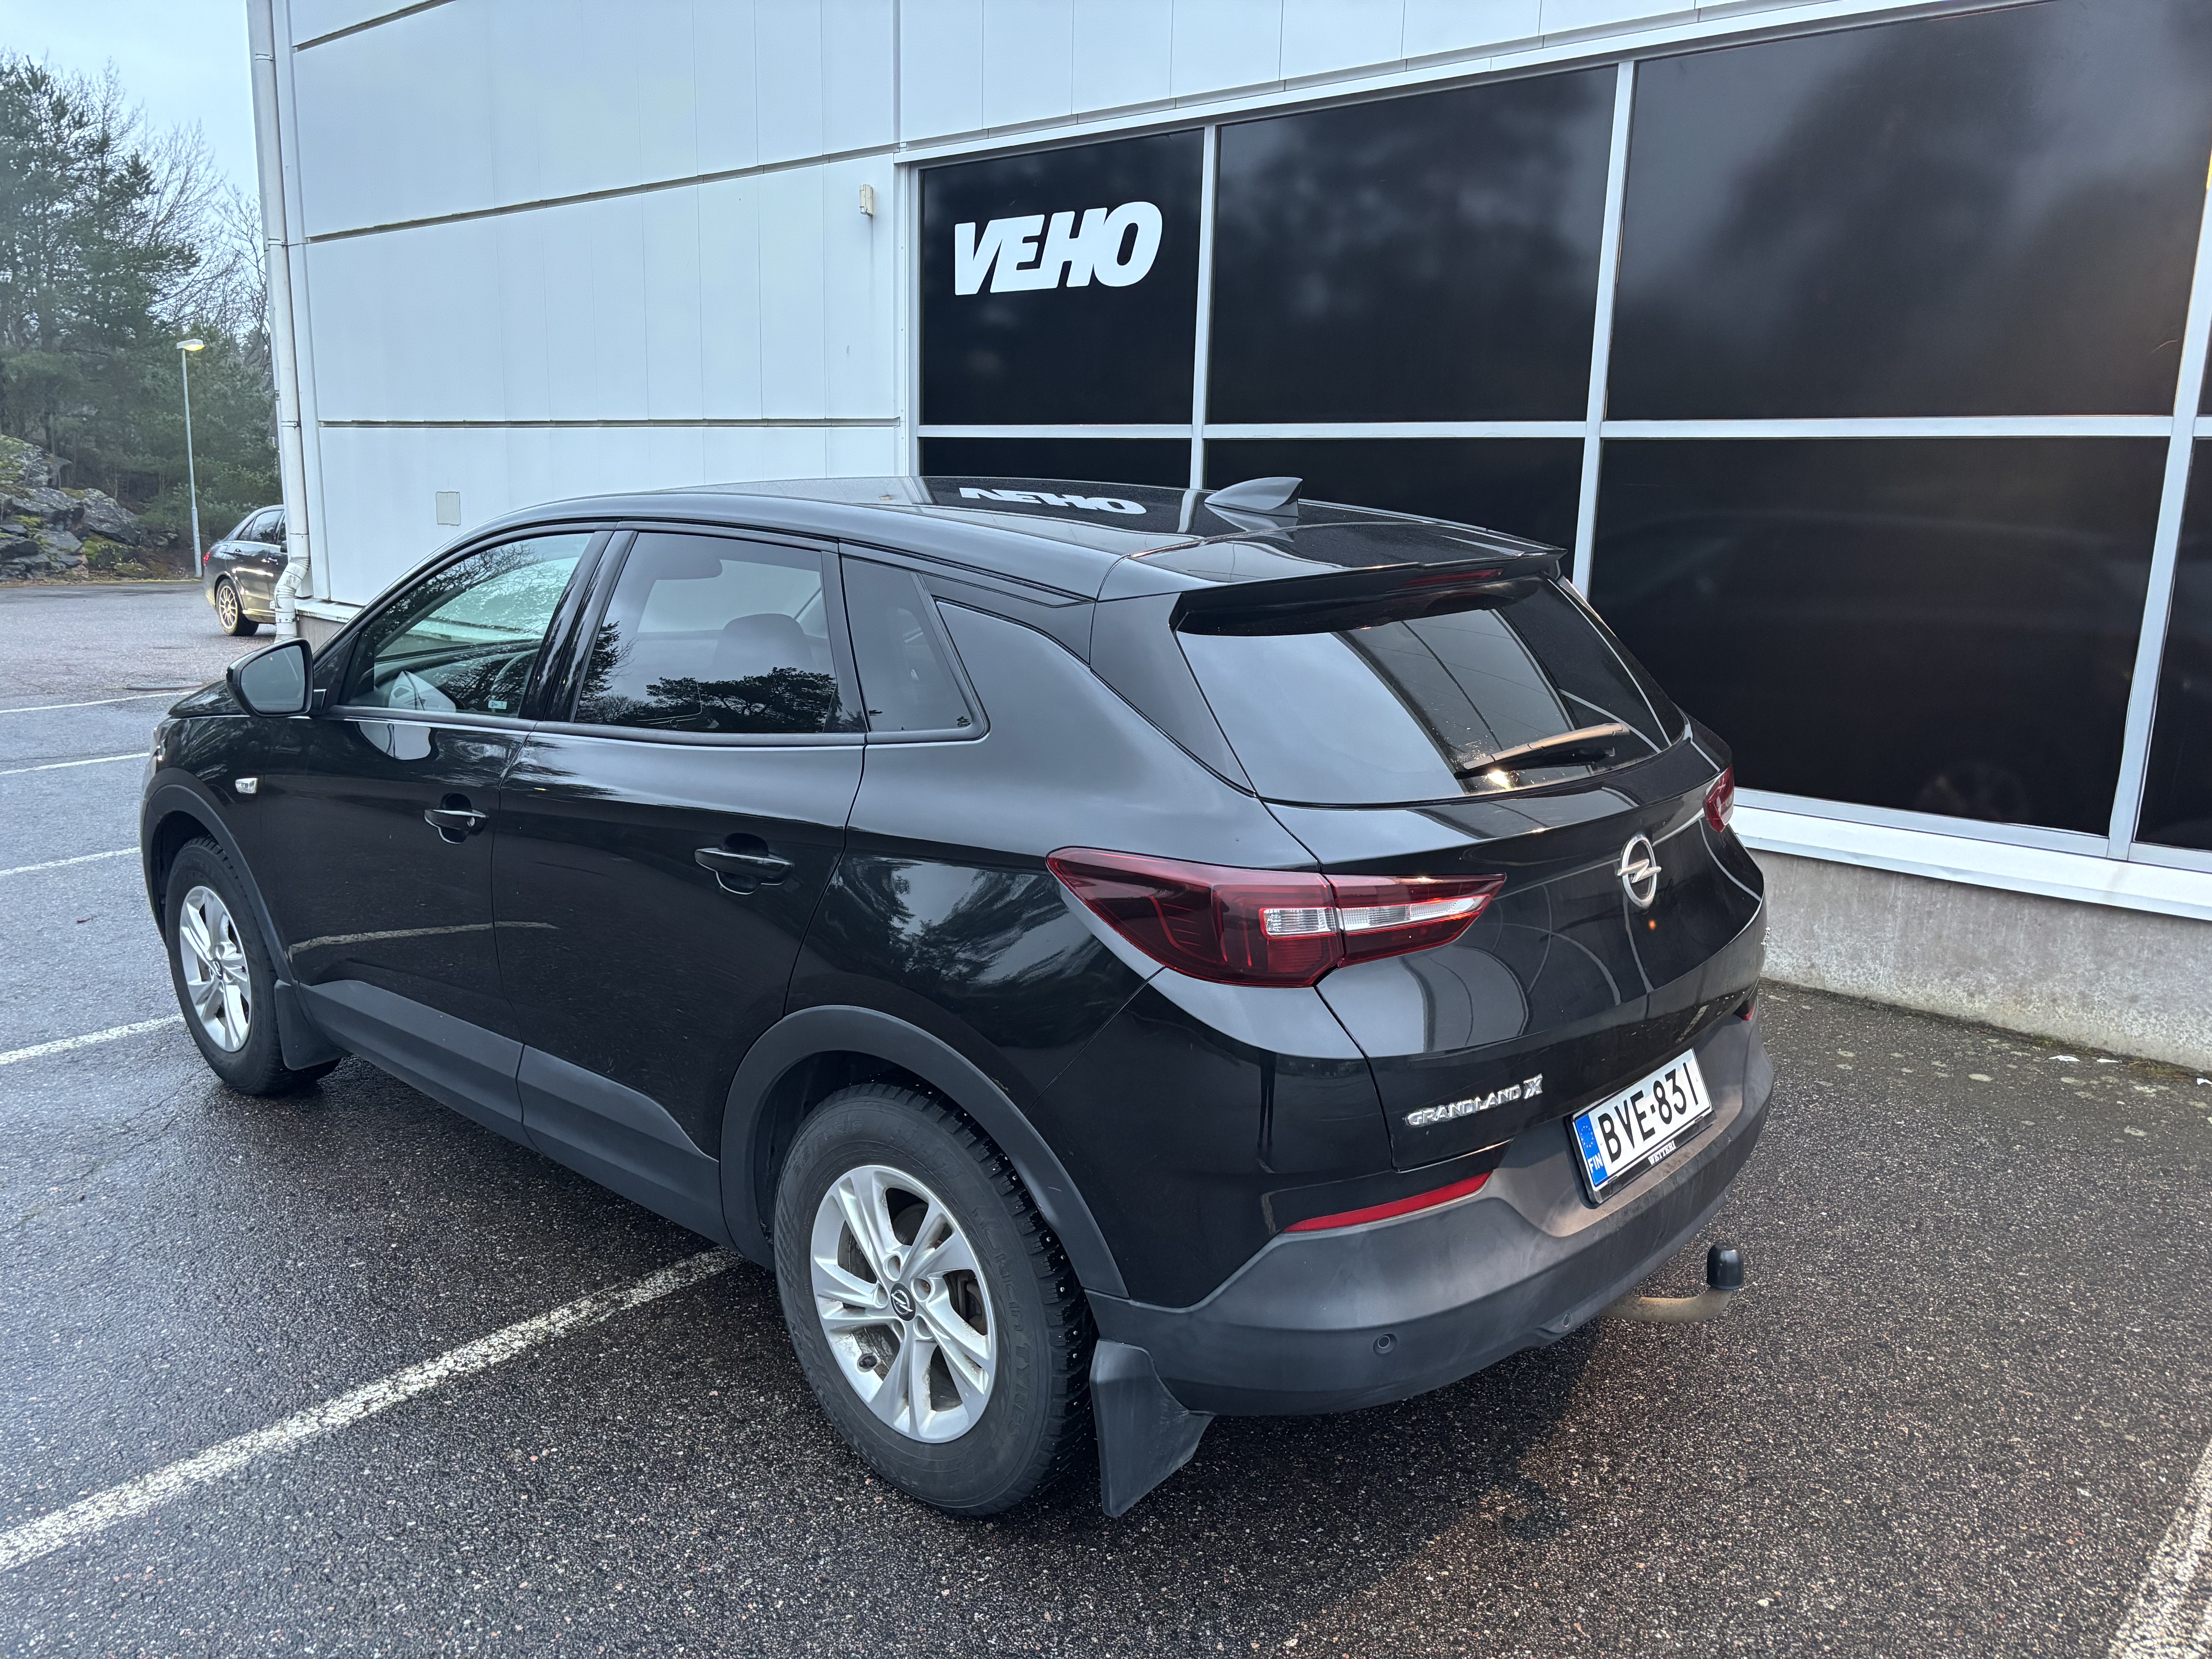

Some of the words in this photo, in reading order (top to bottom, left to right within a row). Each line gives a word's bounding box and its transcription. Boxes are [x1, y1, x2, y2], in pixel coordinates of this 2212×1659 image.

[955, 201, 1162, 295] VEHO
[1406, 1085, 1522, 1126] GRANDLAND
[1523, 1073, 1543, 1099] X
[1598, 1062, 1698, 1164] BVE-831
[1587, 1152, 1604, 1173] FIN
[1648, 1140, 1676, 1165] WETTERI
[1008, 1343, 1030, 1439] TYRES
